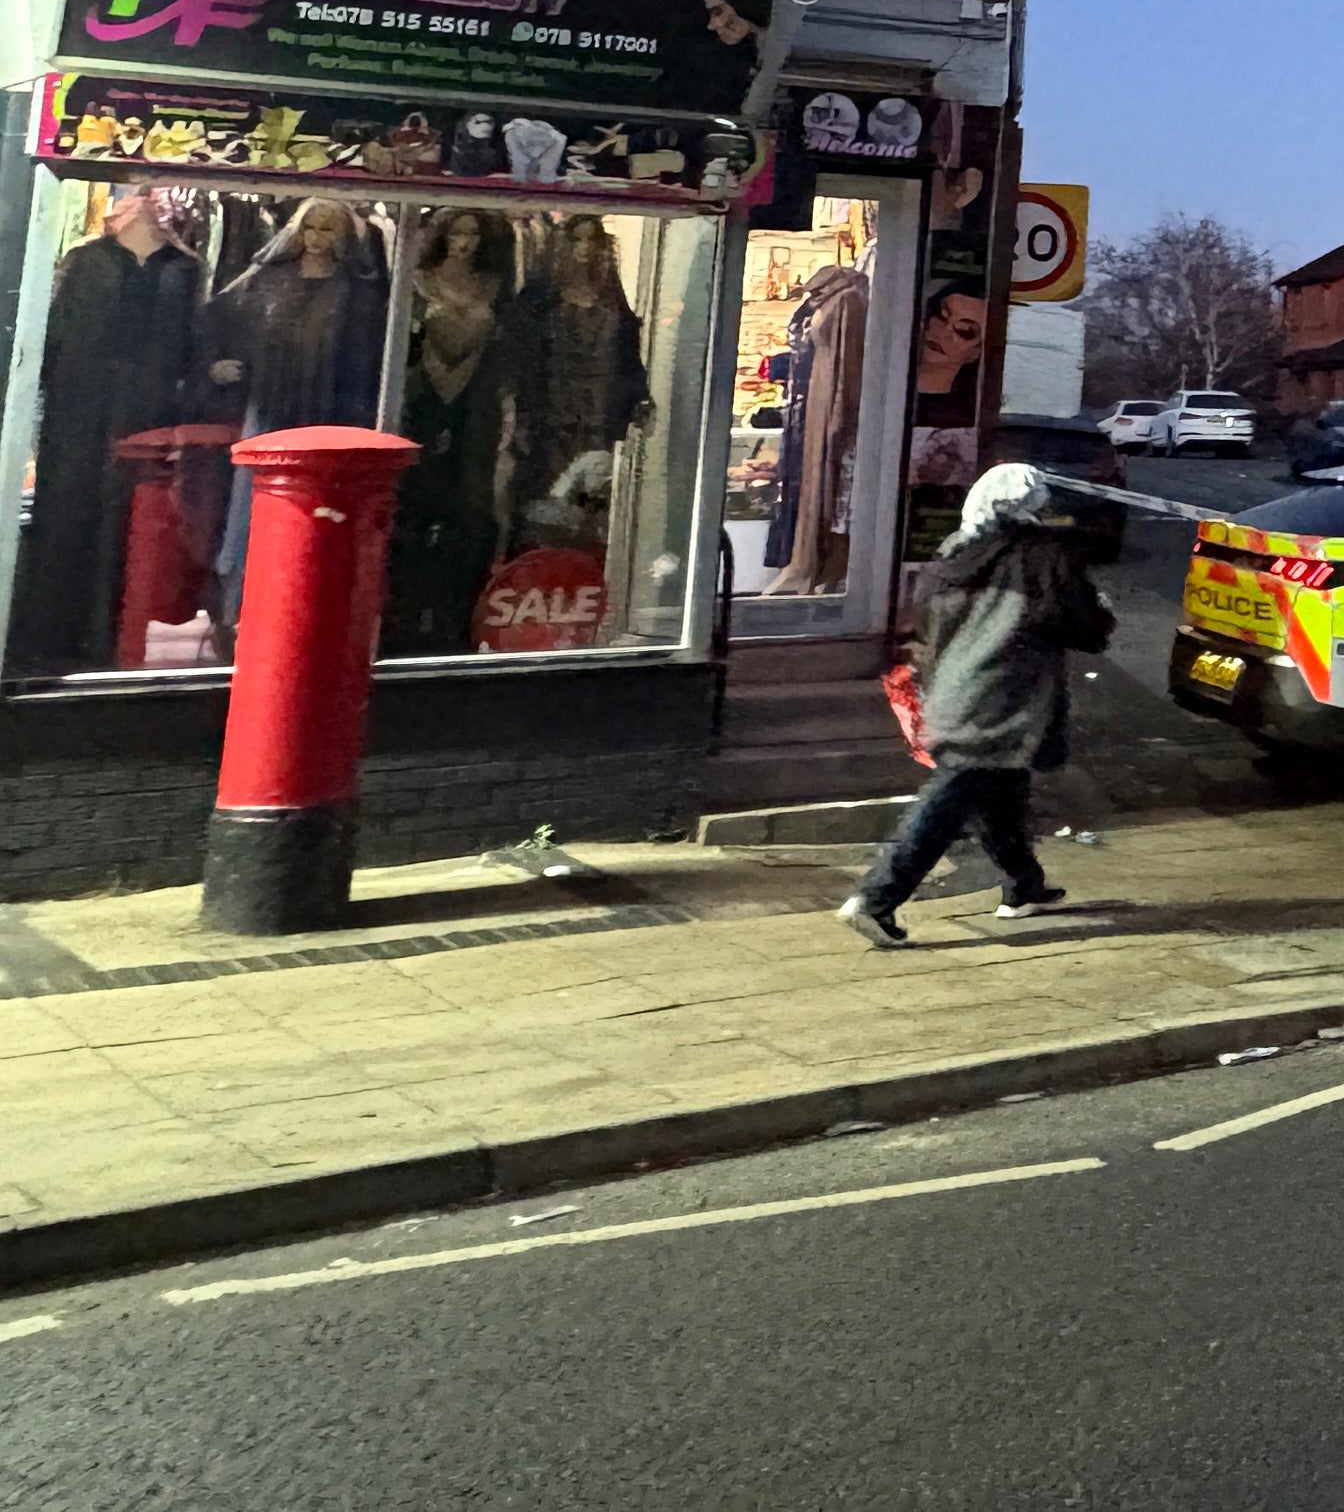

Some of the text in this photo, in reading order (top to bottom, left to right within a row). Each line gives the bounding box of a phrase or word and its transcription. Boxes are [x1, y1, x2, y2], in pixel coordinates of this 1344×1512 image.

[381, 10, 422, 30] 515
[484, 586, 601, 627] SALE
[1186, 583, 1273, 621] POLICE
